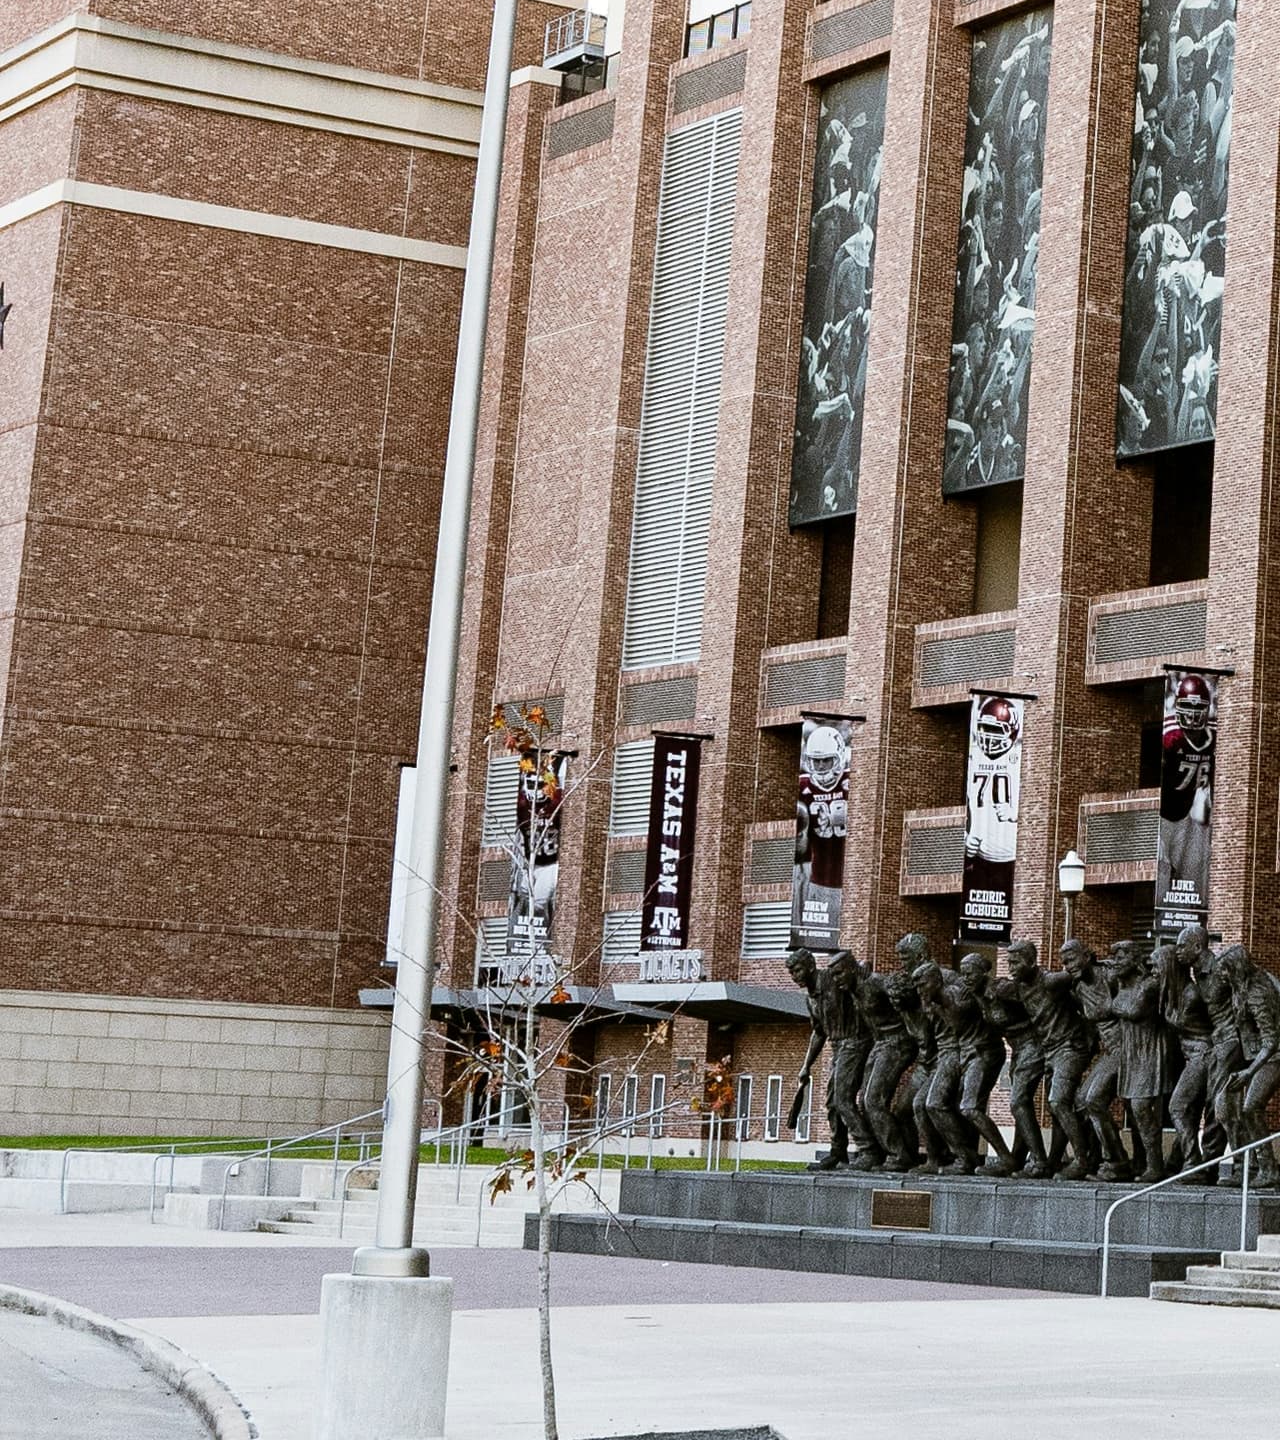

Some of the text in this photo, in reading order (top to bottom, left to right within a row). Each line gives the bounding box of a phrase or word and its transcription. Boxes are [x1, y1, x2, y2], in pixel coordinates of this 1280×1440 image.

[973, 772, 1011, 808] 70
[657, 750, 687, 894] TEXAS A&M
[1171, 879, 1195, 891] LUKE
[969, 889, 1006, 904] CEDRIC
[1163, 891, 1201, 904] JOECKEL
[965, 903, 1008, 918] OGBUEHI
[639, 949, 704, 981] TICKETS
